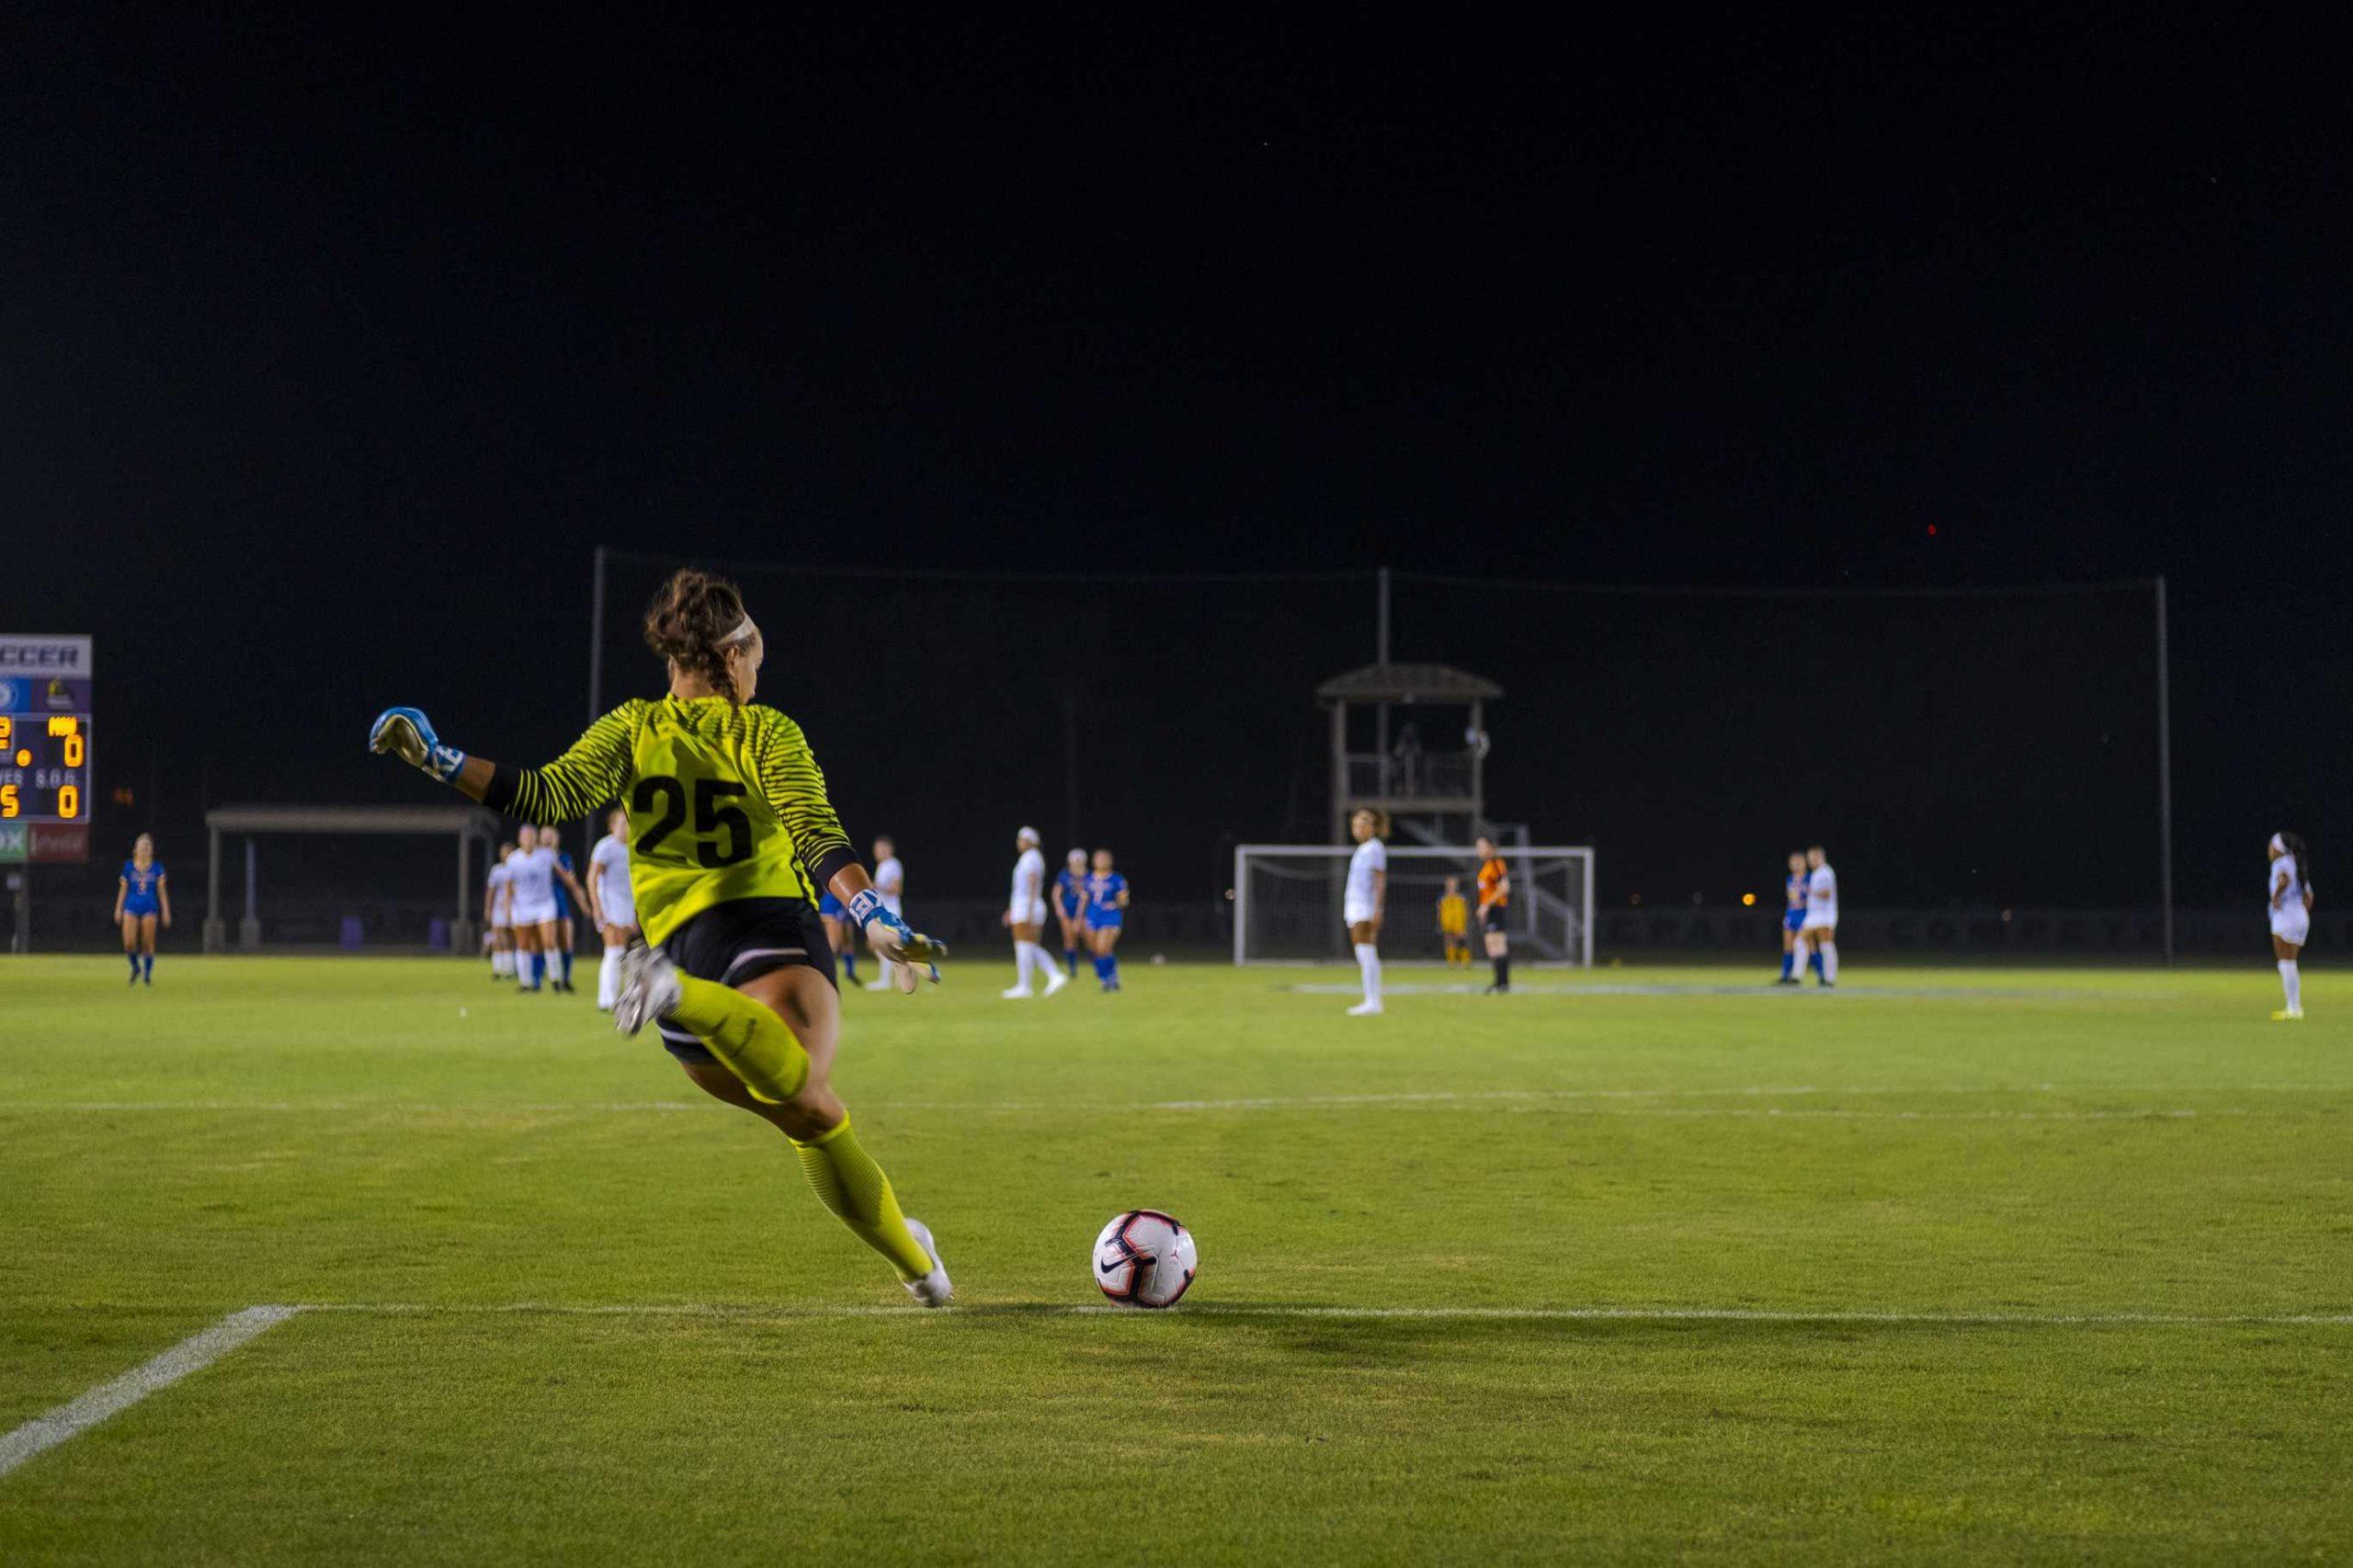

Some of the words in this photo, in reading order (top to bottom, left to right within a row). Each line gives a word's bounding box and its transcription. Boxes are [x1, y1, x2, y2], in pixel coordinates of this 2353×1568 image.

[63, 734, 85, 768] 0
[0, 784, 20, 819] 5
[58, 784, 79, 819] 0
[632, 775, 753, 869] 25
